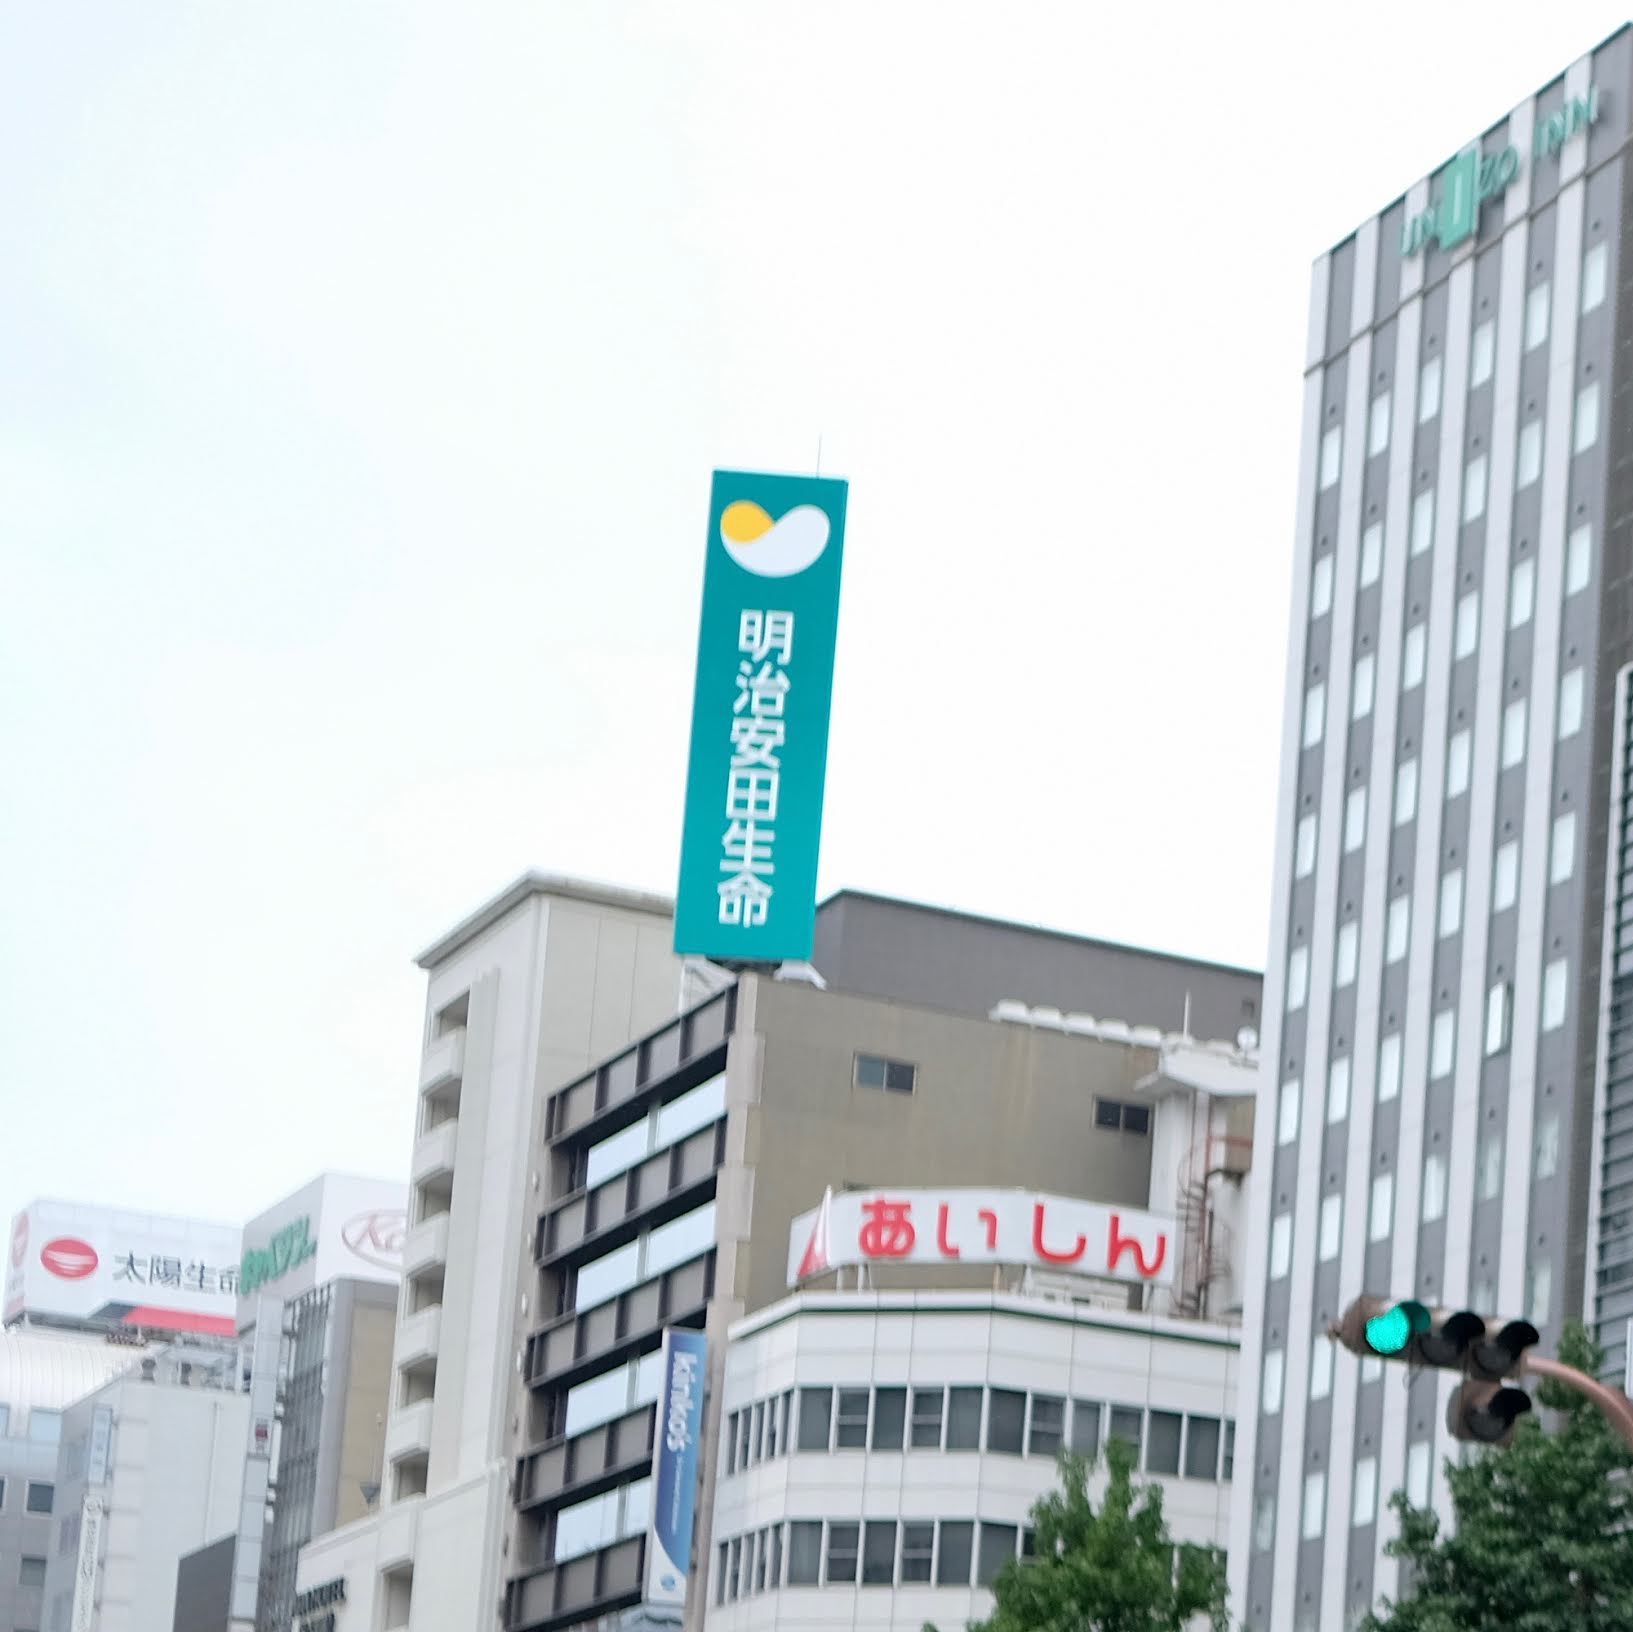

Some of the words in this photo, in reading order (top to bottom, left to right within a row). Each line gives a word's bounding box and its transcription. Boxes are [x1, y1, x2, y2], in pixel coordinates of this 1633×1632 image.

[716, 608, 795, 929] 明治安田生命
[857, 1197, 1166, 1282] あいしん
